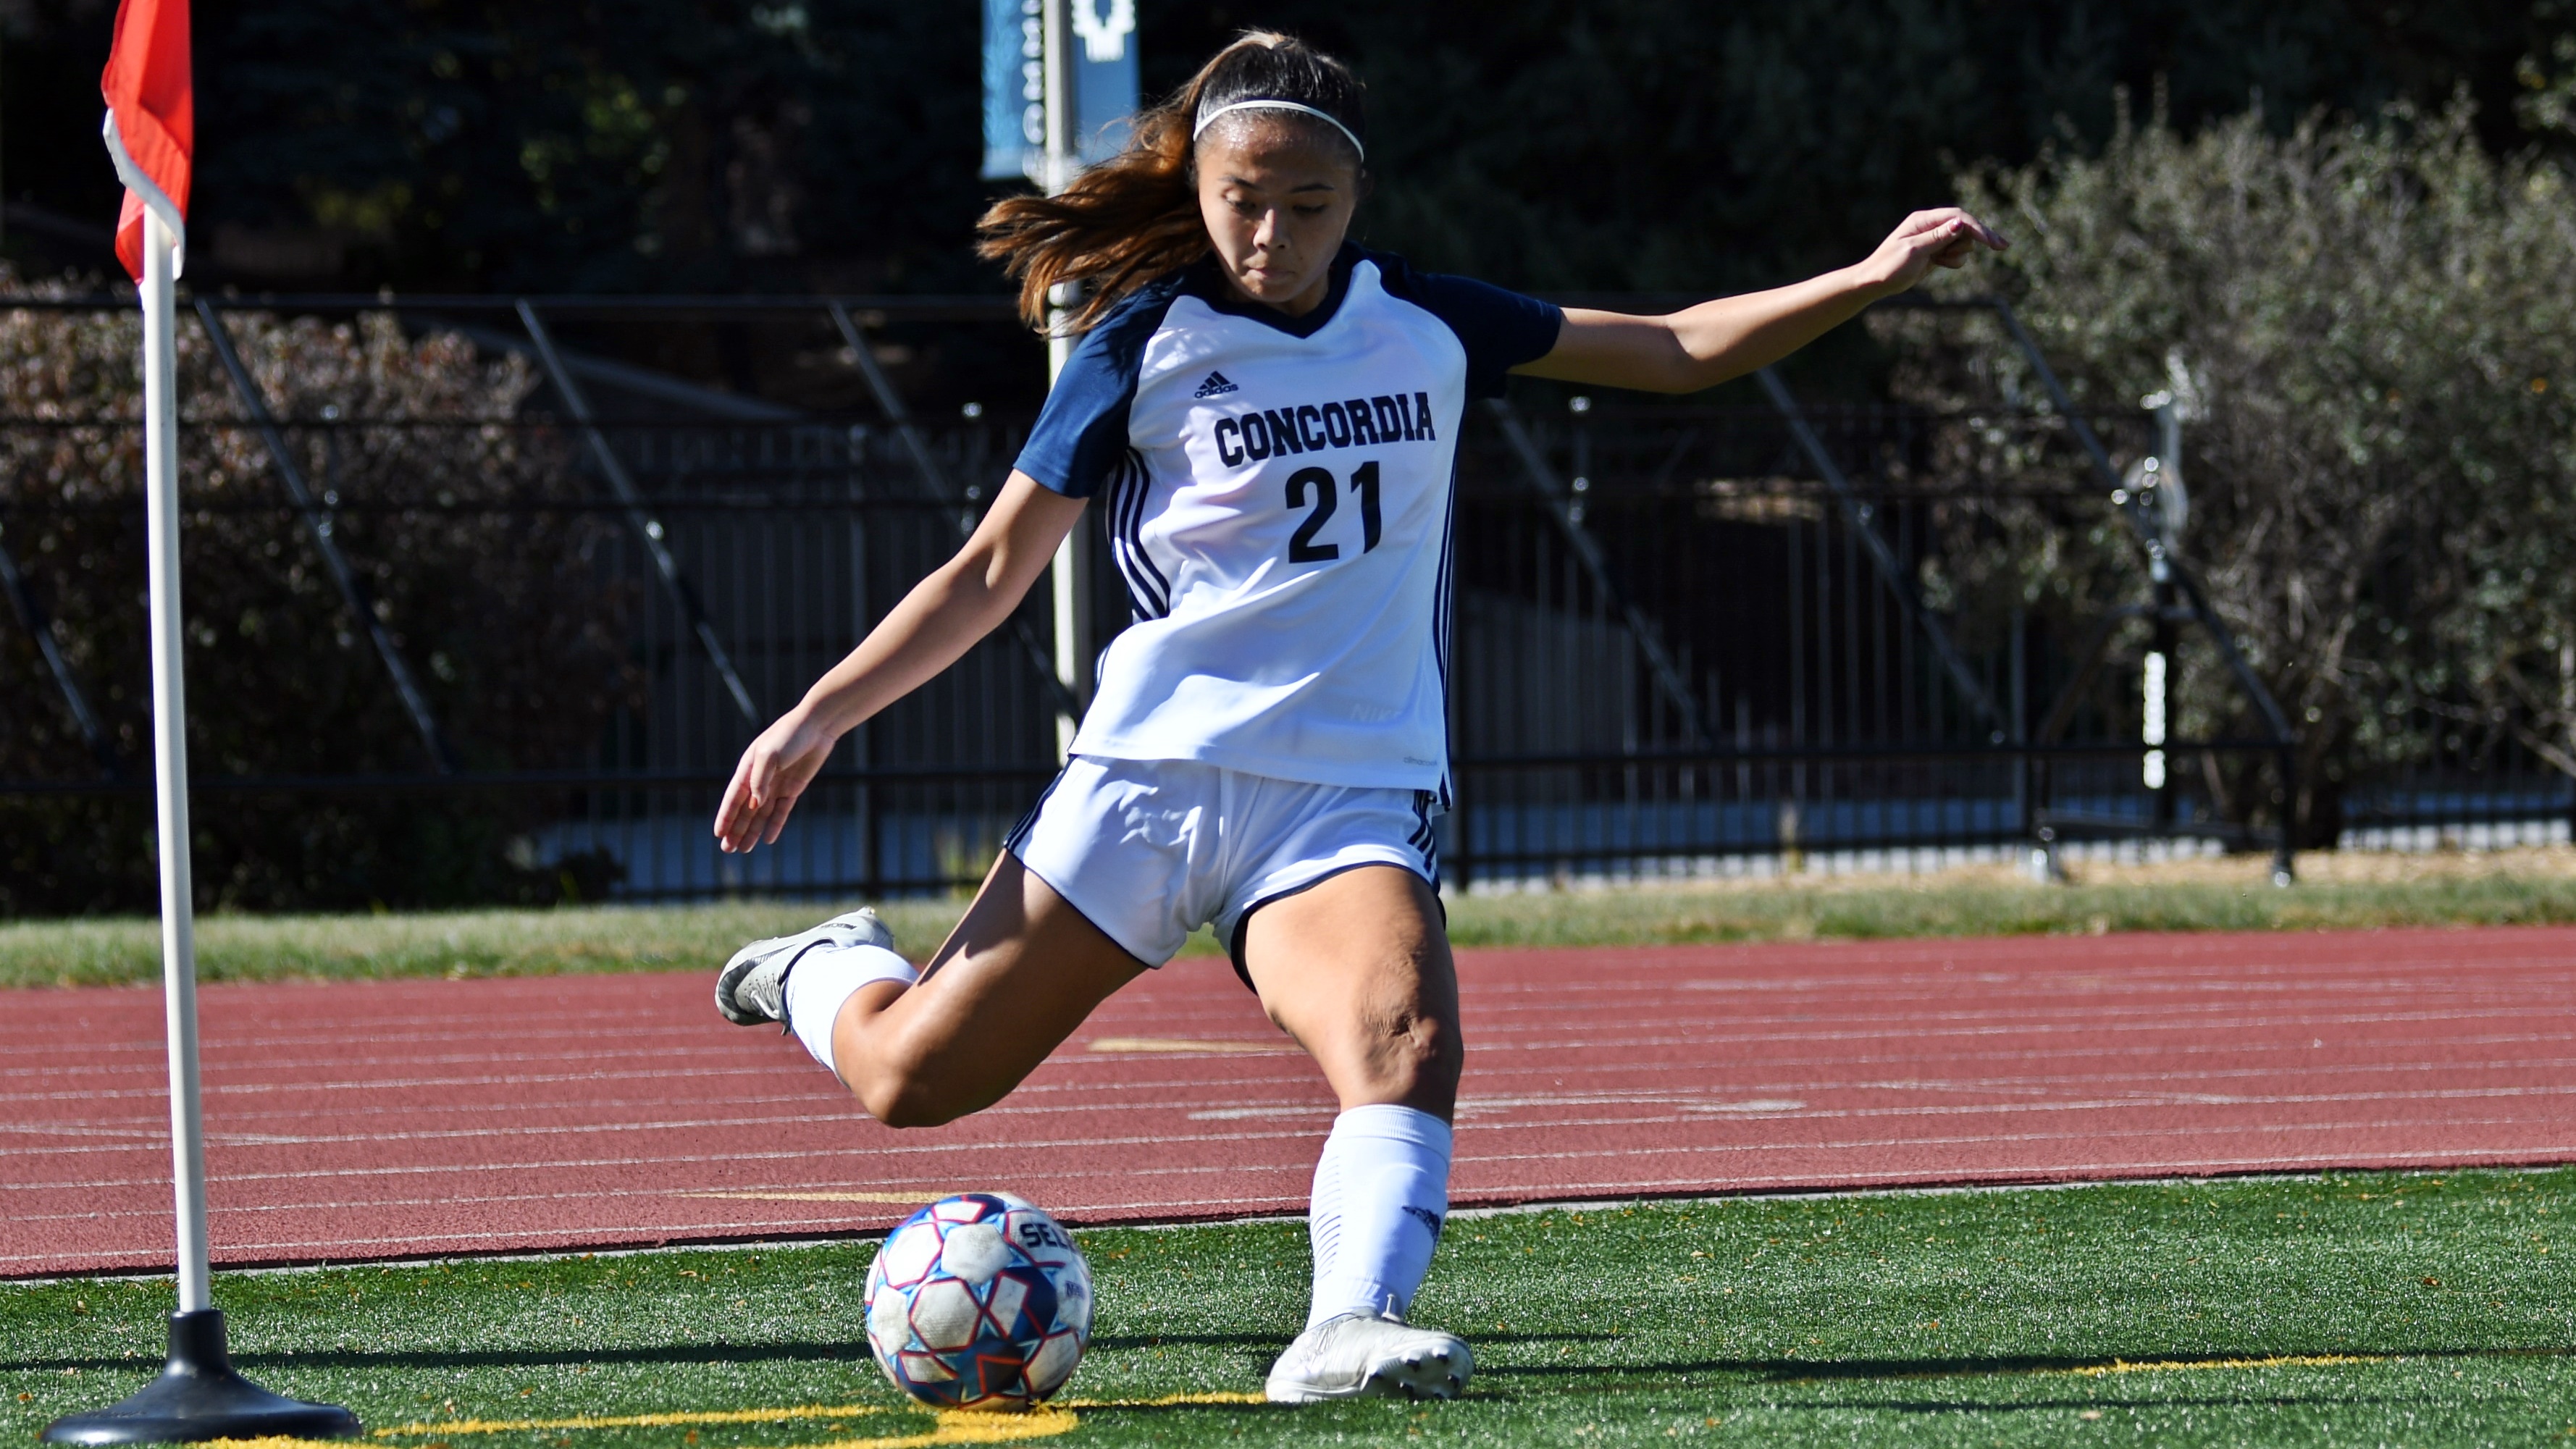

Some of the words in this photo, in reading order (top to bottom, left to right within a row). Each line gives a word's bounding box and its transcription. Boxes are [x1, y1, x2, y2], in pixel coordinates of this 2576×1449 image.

[1194, 383, 1239, 399] adidas
[1214, 392, 1436, 468] CONCORDIA
[1285, 461, 1382, 564] 21
[1020, 1223, 1073, 1250] SEL
